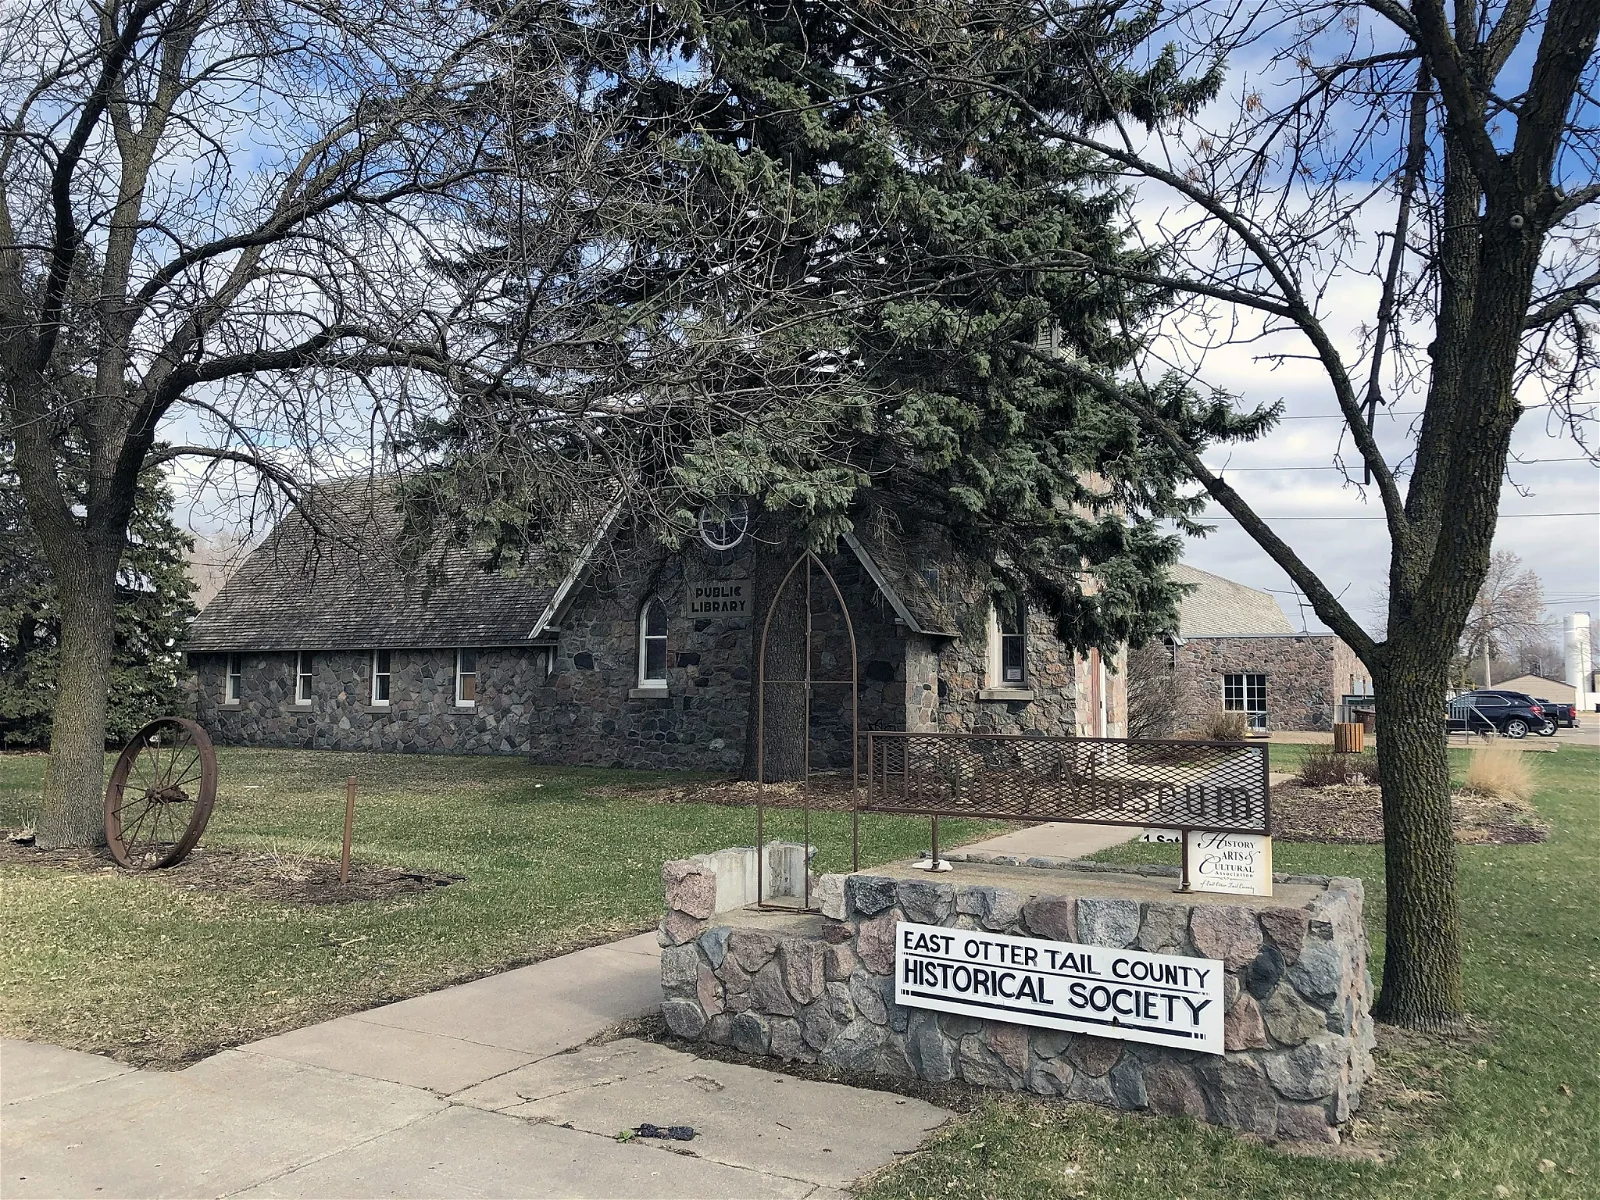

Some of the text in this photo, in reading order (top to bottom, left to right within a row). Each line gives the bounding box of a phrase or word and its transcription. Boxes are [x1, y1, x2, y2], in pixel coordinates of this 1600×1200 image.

[695, 586, 742, 598] PUBLIC
[691, 600, 746, 613] LIBRARY
[1056, 749, 1252, 818] Museum
[1197, 831, 1255, 849] HISTORY
[1198, 853, 1255, 874] CULTURAL
[1222, 850, 1261, 865] ARTS &
[903, 930, 1211, 989] EAST OTTER TAIL COUNTY
[904, 958, 1213, 1027] HISTORICAL SOCIETY
